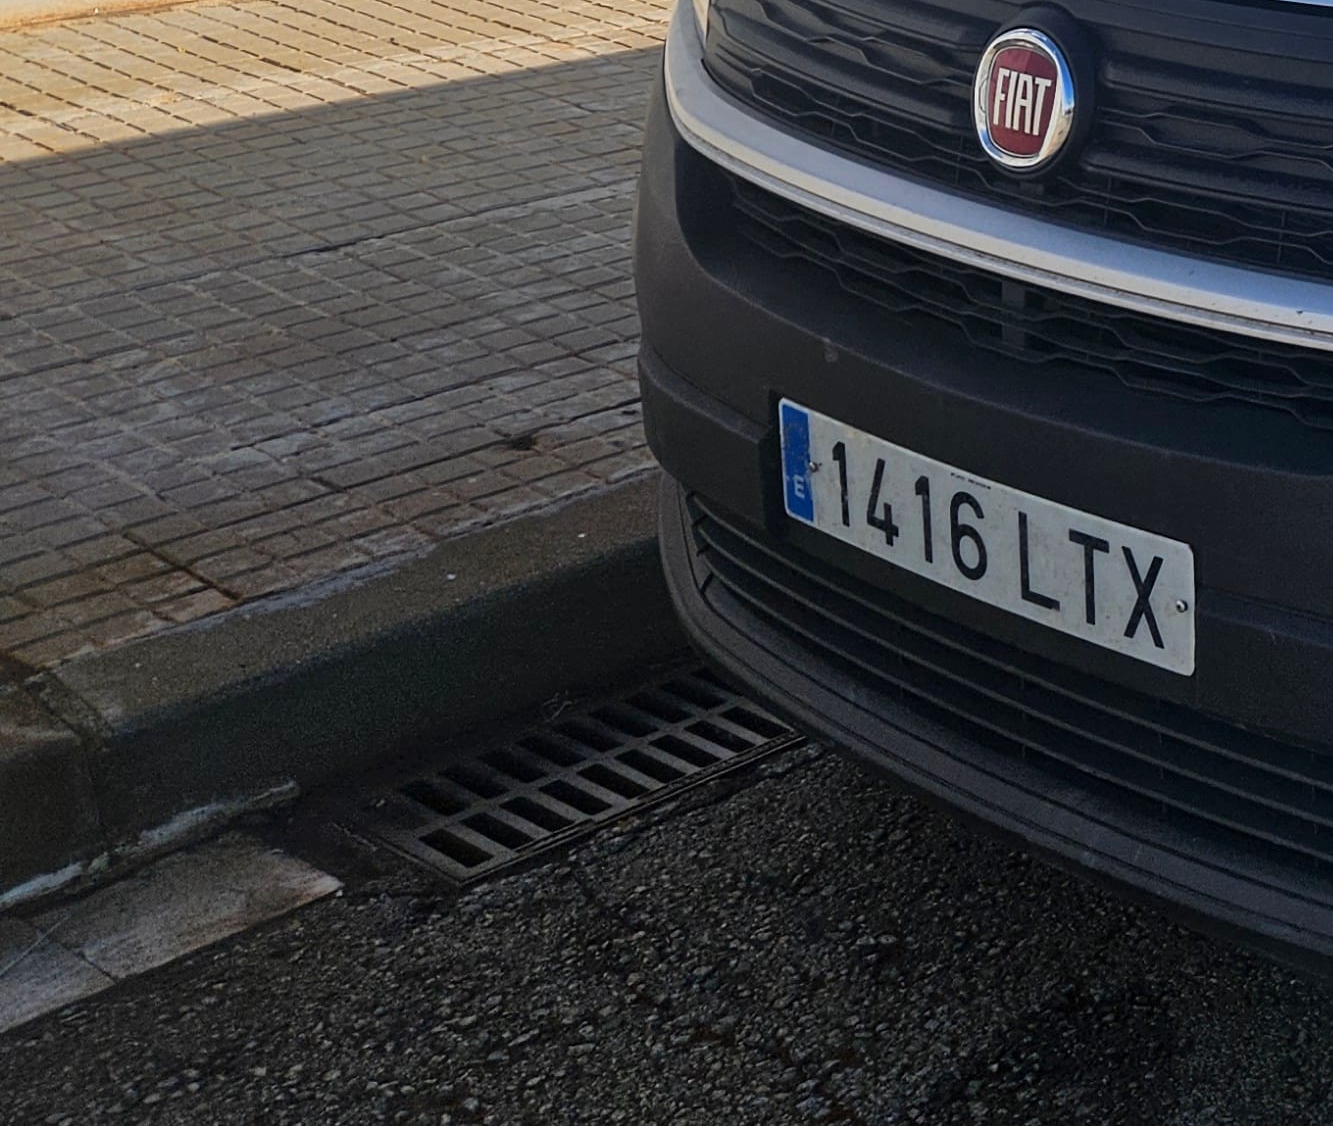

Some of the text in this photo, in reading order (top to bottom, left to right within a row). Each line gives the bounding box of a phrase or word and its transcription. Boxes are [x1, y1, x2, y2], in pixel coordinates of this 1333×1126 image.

[993, 68, 1052, 136] FIAT
[793, 475, 806, 499] E
[832, 441, 1165, 649] 1416 LTX
